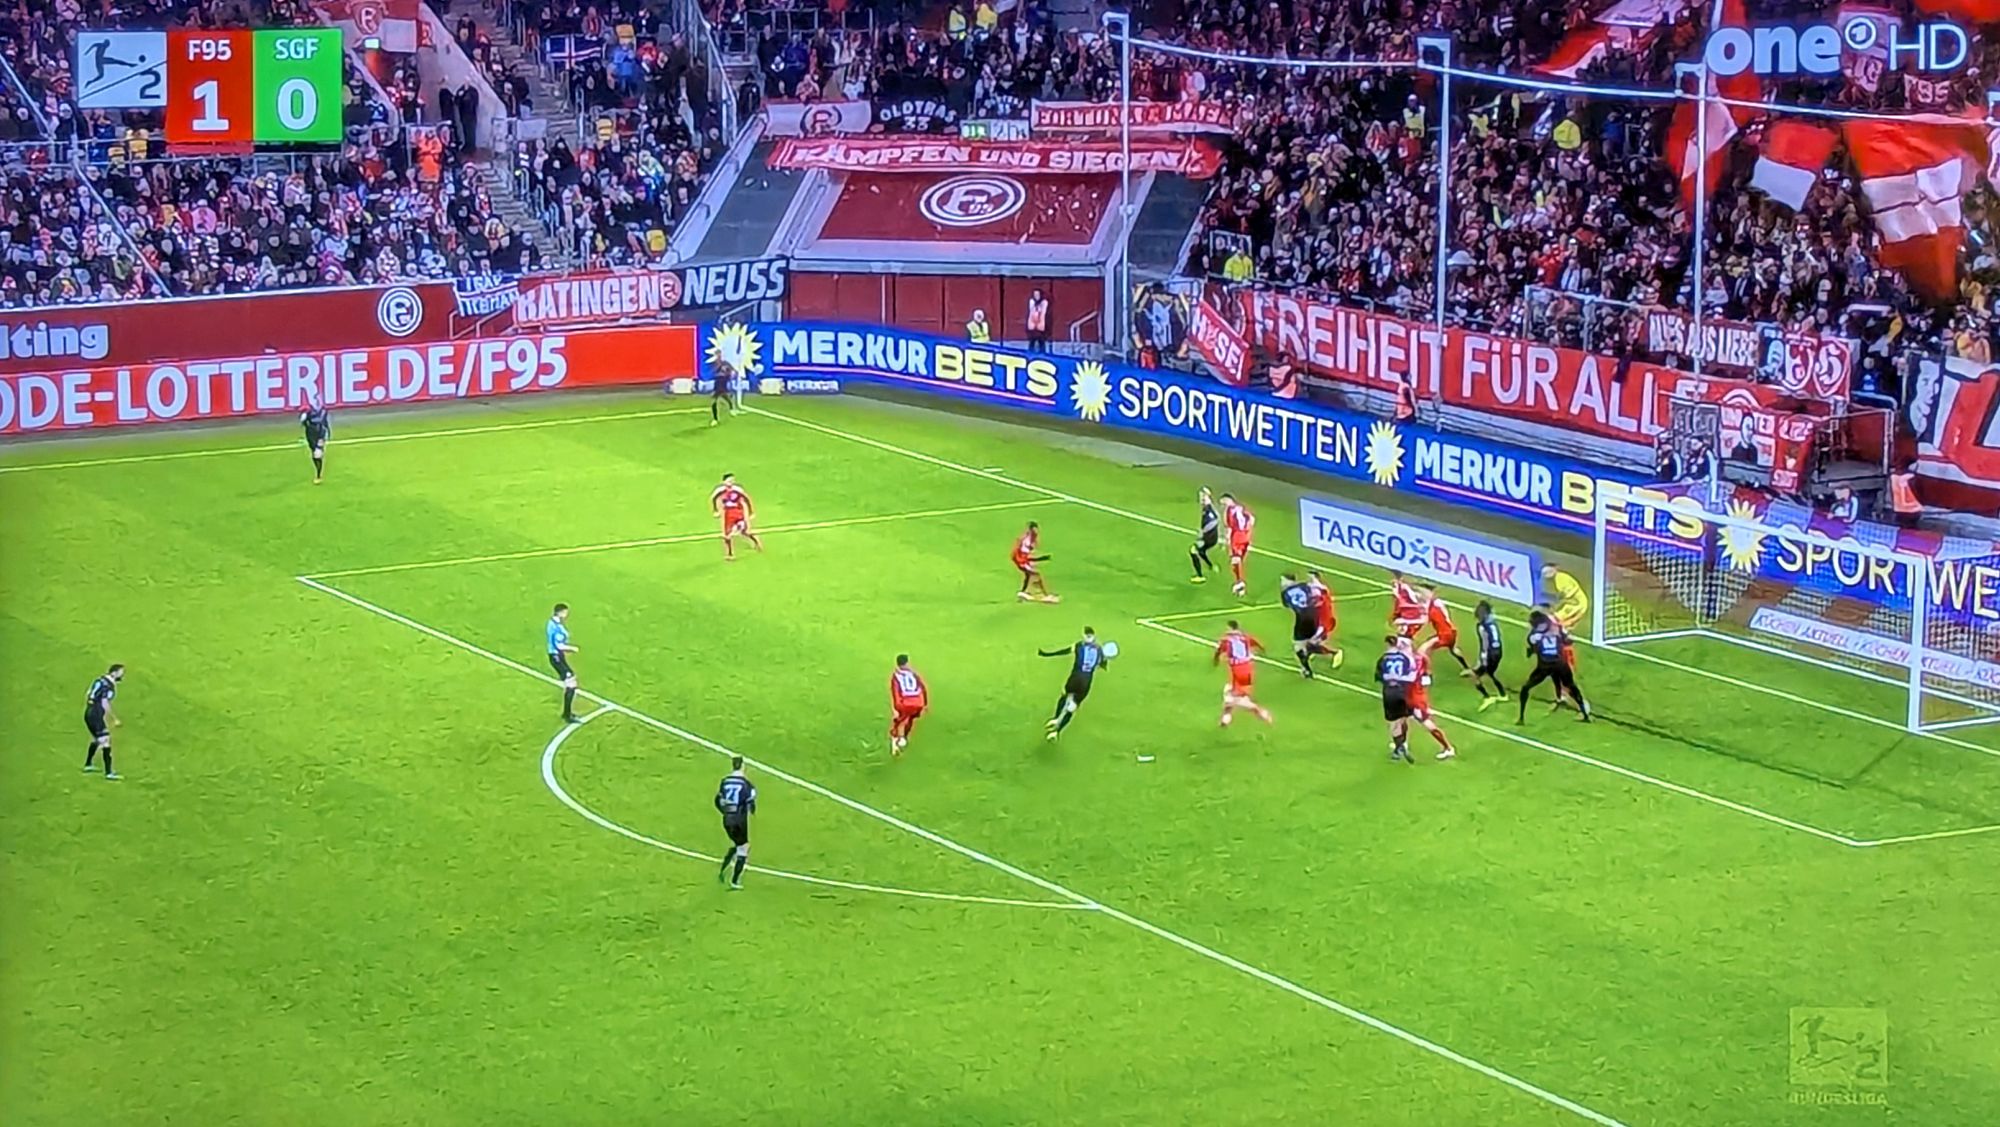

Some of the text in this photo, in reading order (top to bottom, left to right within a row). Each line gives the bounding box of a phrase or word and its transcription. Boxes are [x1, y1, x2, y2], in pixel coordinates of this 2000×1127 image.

[795, 143, 1180, 172] KÄMPFEN UND SIEGEN
[683, 262, 786, 306] NEUSS
[773, 330, 1058, 397] MERKUR BETS
[1253, 291, 1448, 393] FREIHEIT
[1462, 335, 1559, 412] FÜR
[1118, 377, 1357, 467] SPORTWETTEN
[1414, 437, 1705, 539] MERKUR BETS
[1313, 516, 1519, 592] TARGO BANK
